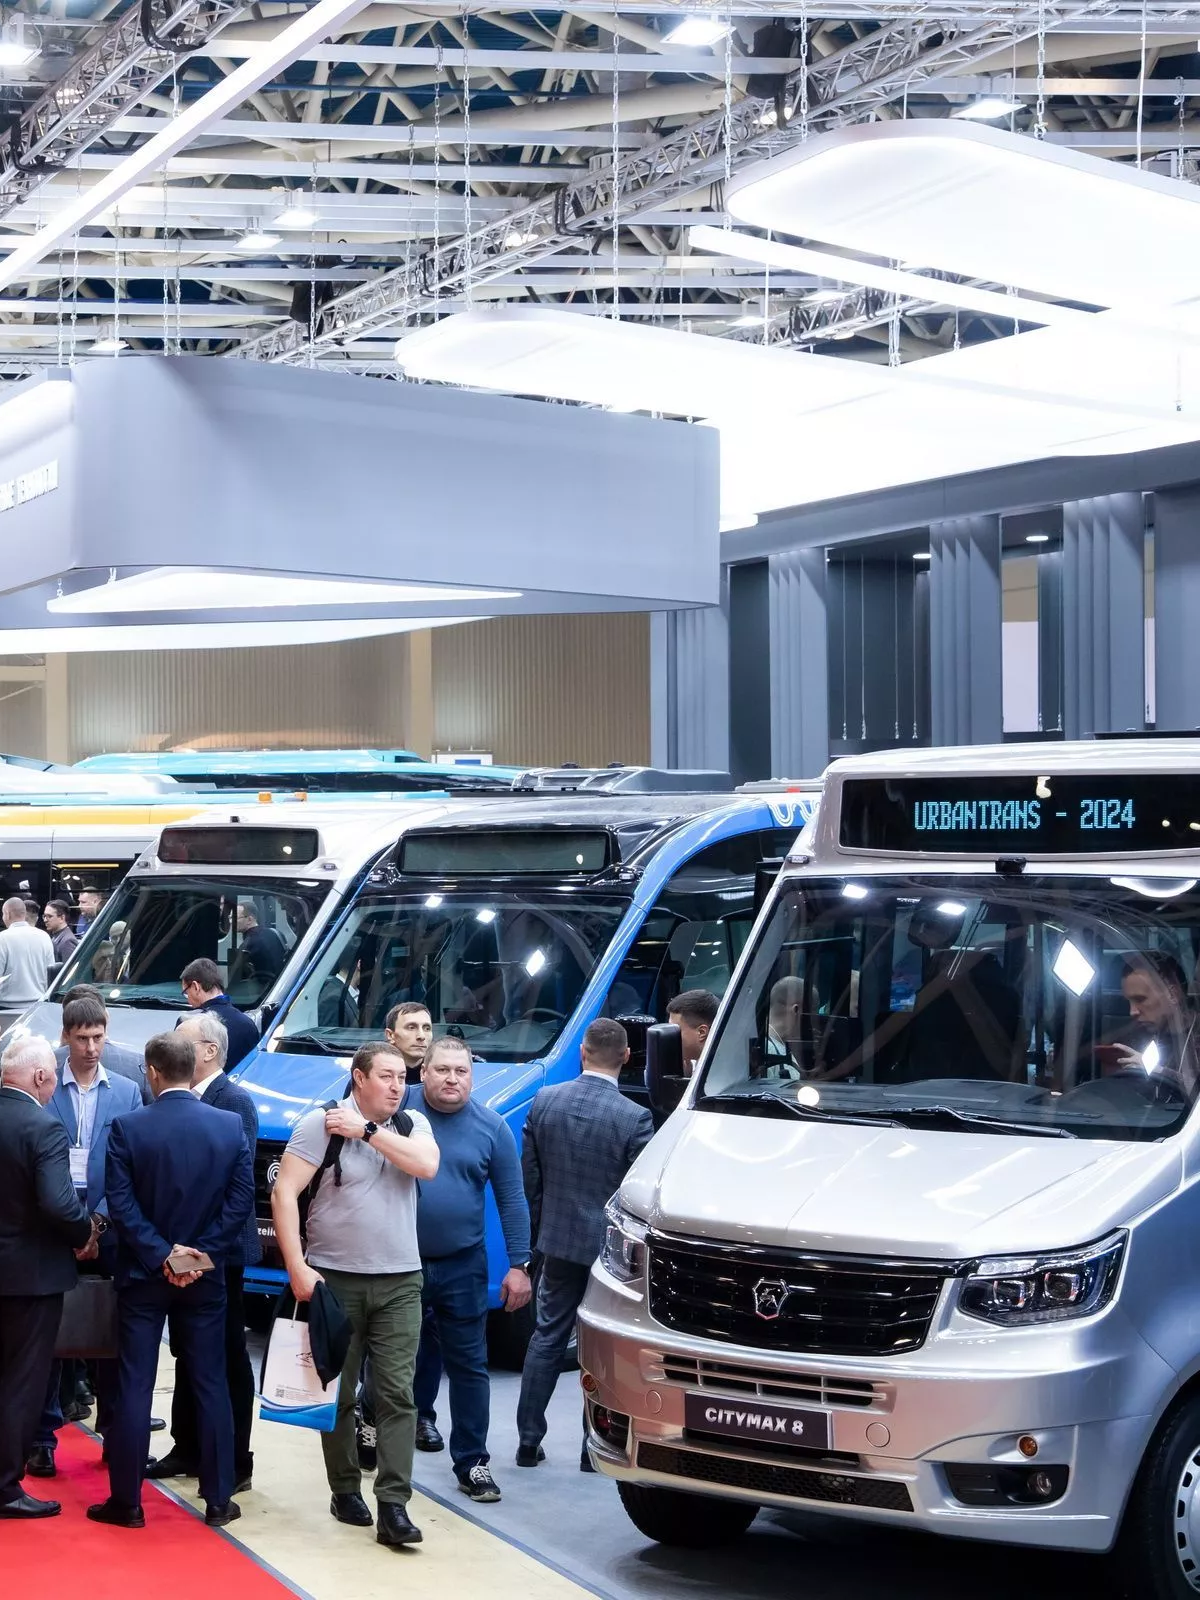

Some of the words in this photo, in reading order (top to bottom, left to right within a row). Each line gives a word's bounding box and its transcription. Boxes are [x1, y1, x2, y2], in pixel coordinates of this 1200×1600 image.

[914, 800, 1041, 830] URBANTRANS
[1080, 798, 1136, 829] 2024
[704, 1407, 787, 1434] CITYMAX
[791, 1419, 804, 1436] 8
